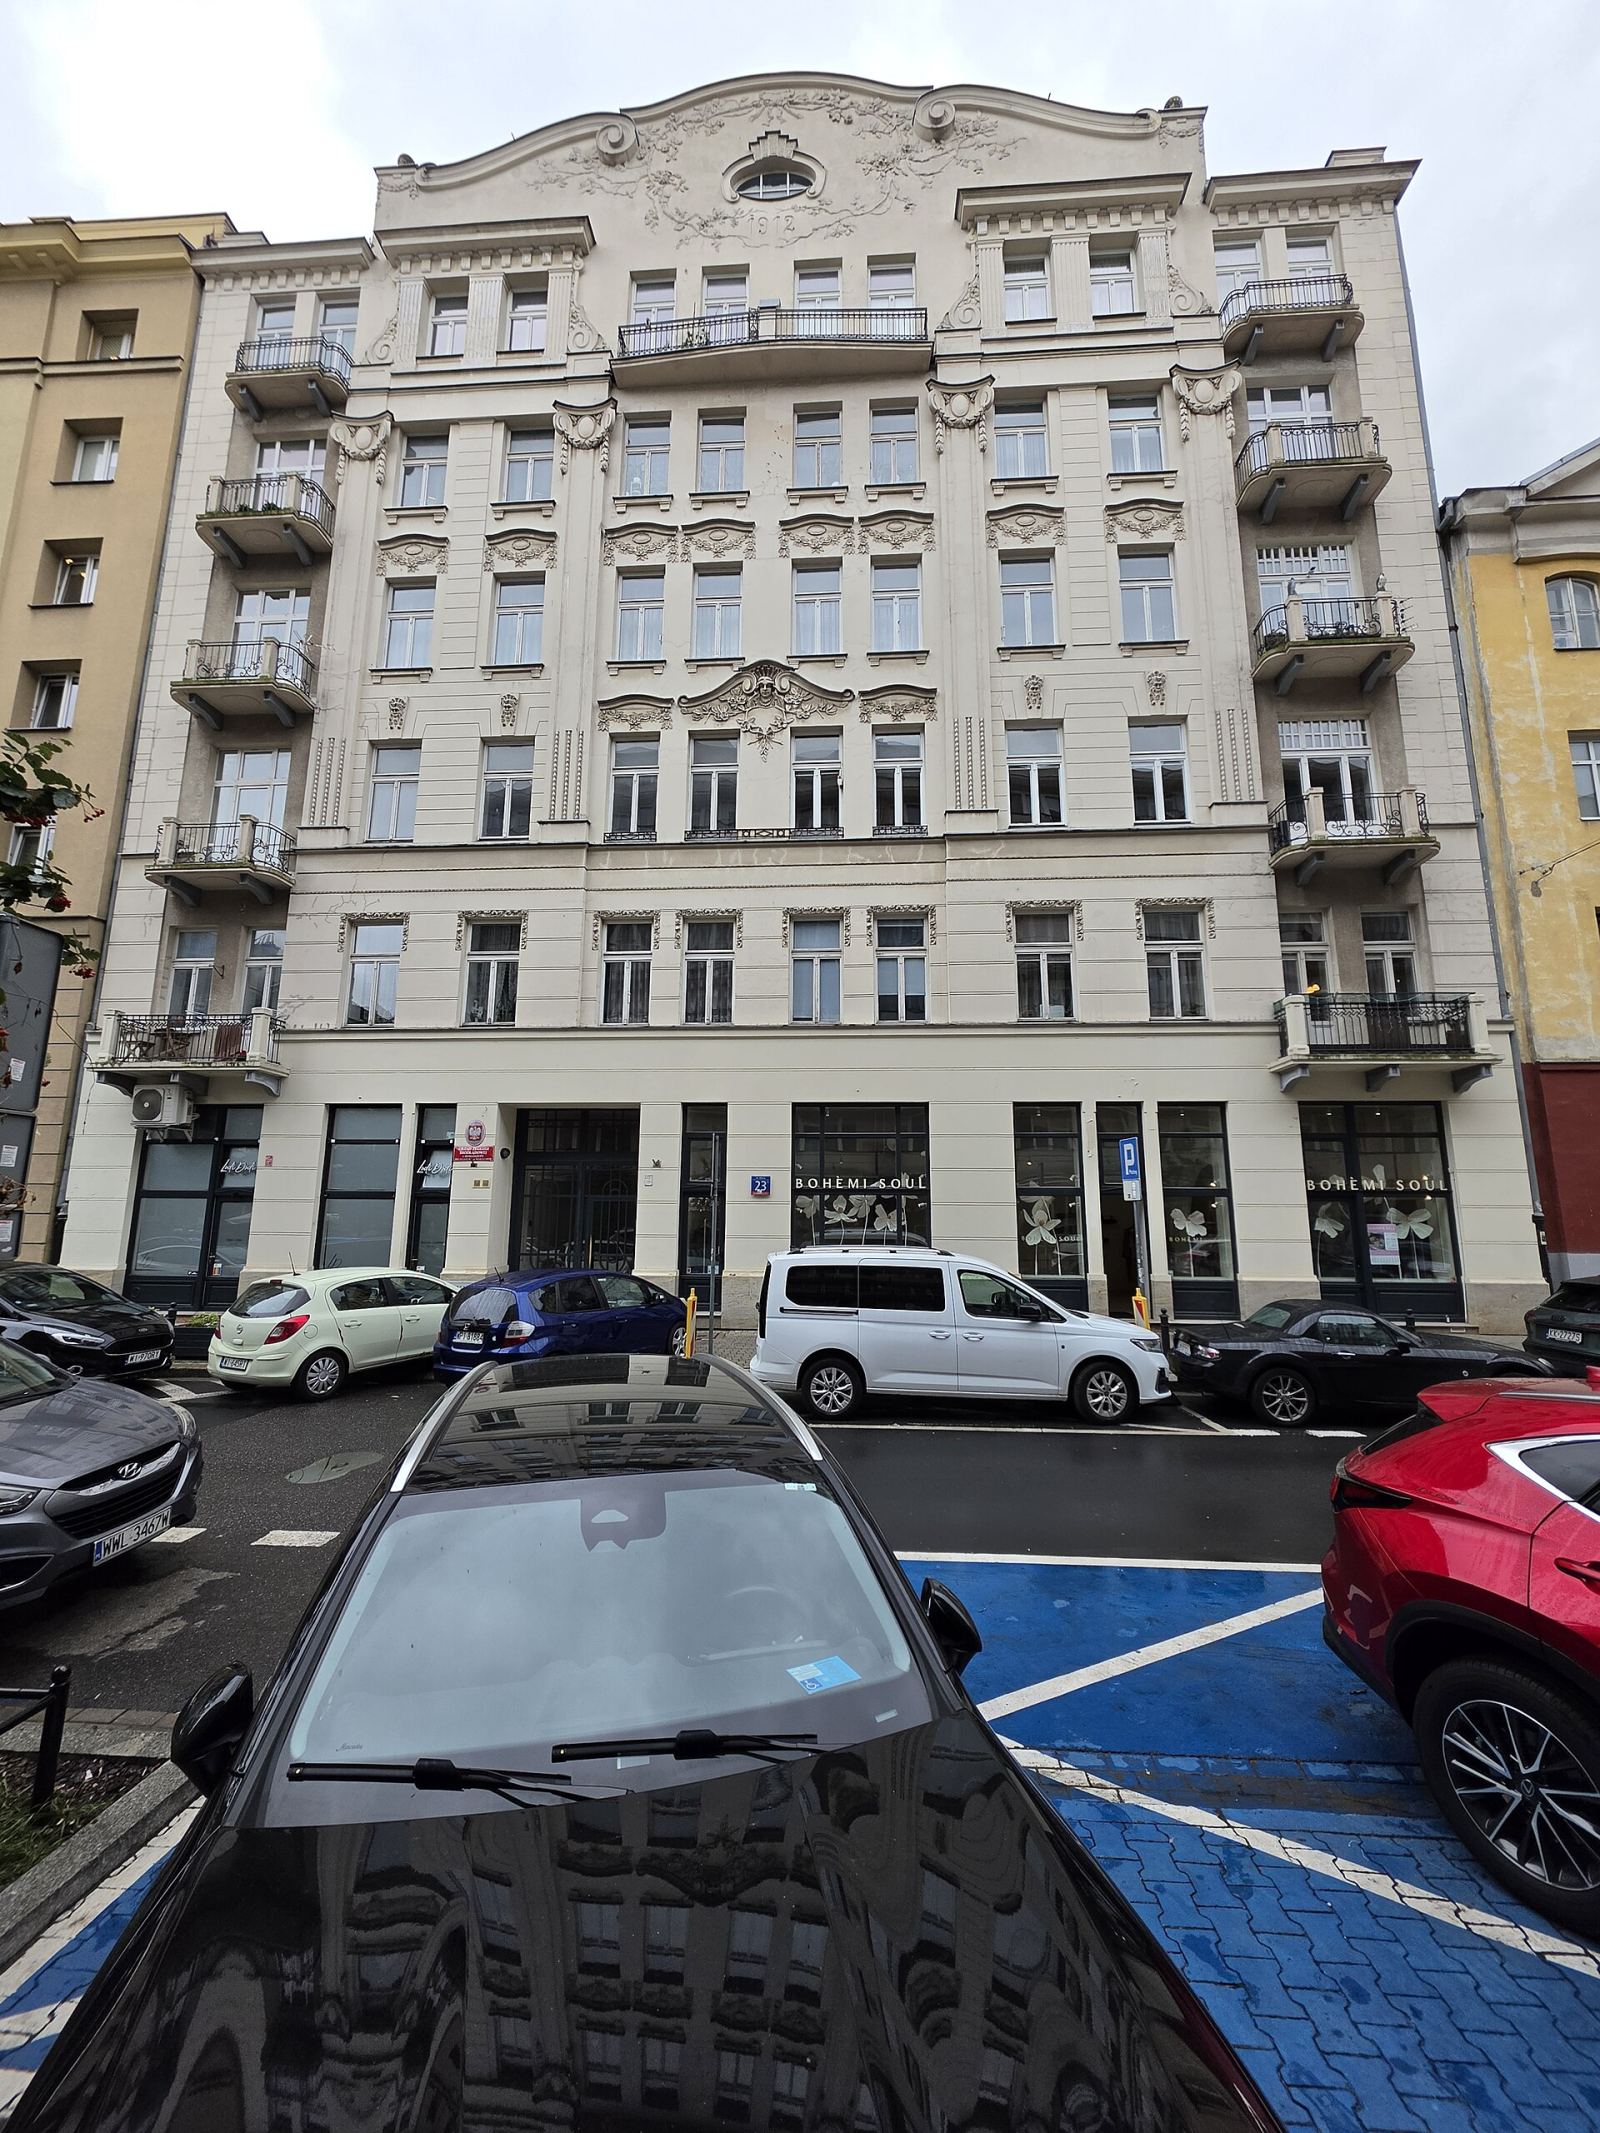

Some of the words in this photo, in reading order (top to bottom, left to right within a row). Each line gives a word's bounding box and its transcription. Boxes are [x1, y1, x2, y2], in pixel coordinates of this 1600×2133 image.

[1123, 1143, 1135, 1176] P
[754, 1180, 767, 1191] 23
[795, 1175, 867, 1189] BOHÈMI
[879, 1178, 926, 1189] SOUL
[1307, 1176, 1385, 1191] BOHÈMI
[1396, 1179, 1448, 1191] SOUL
[103, 1533, 128, 1557] WWL
[133, 1511, 170, 1541] 3467W
